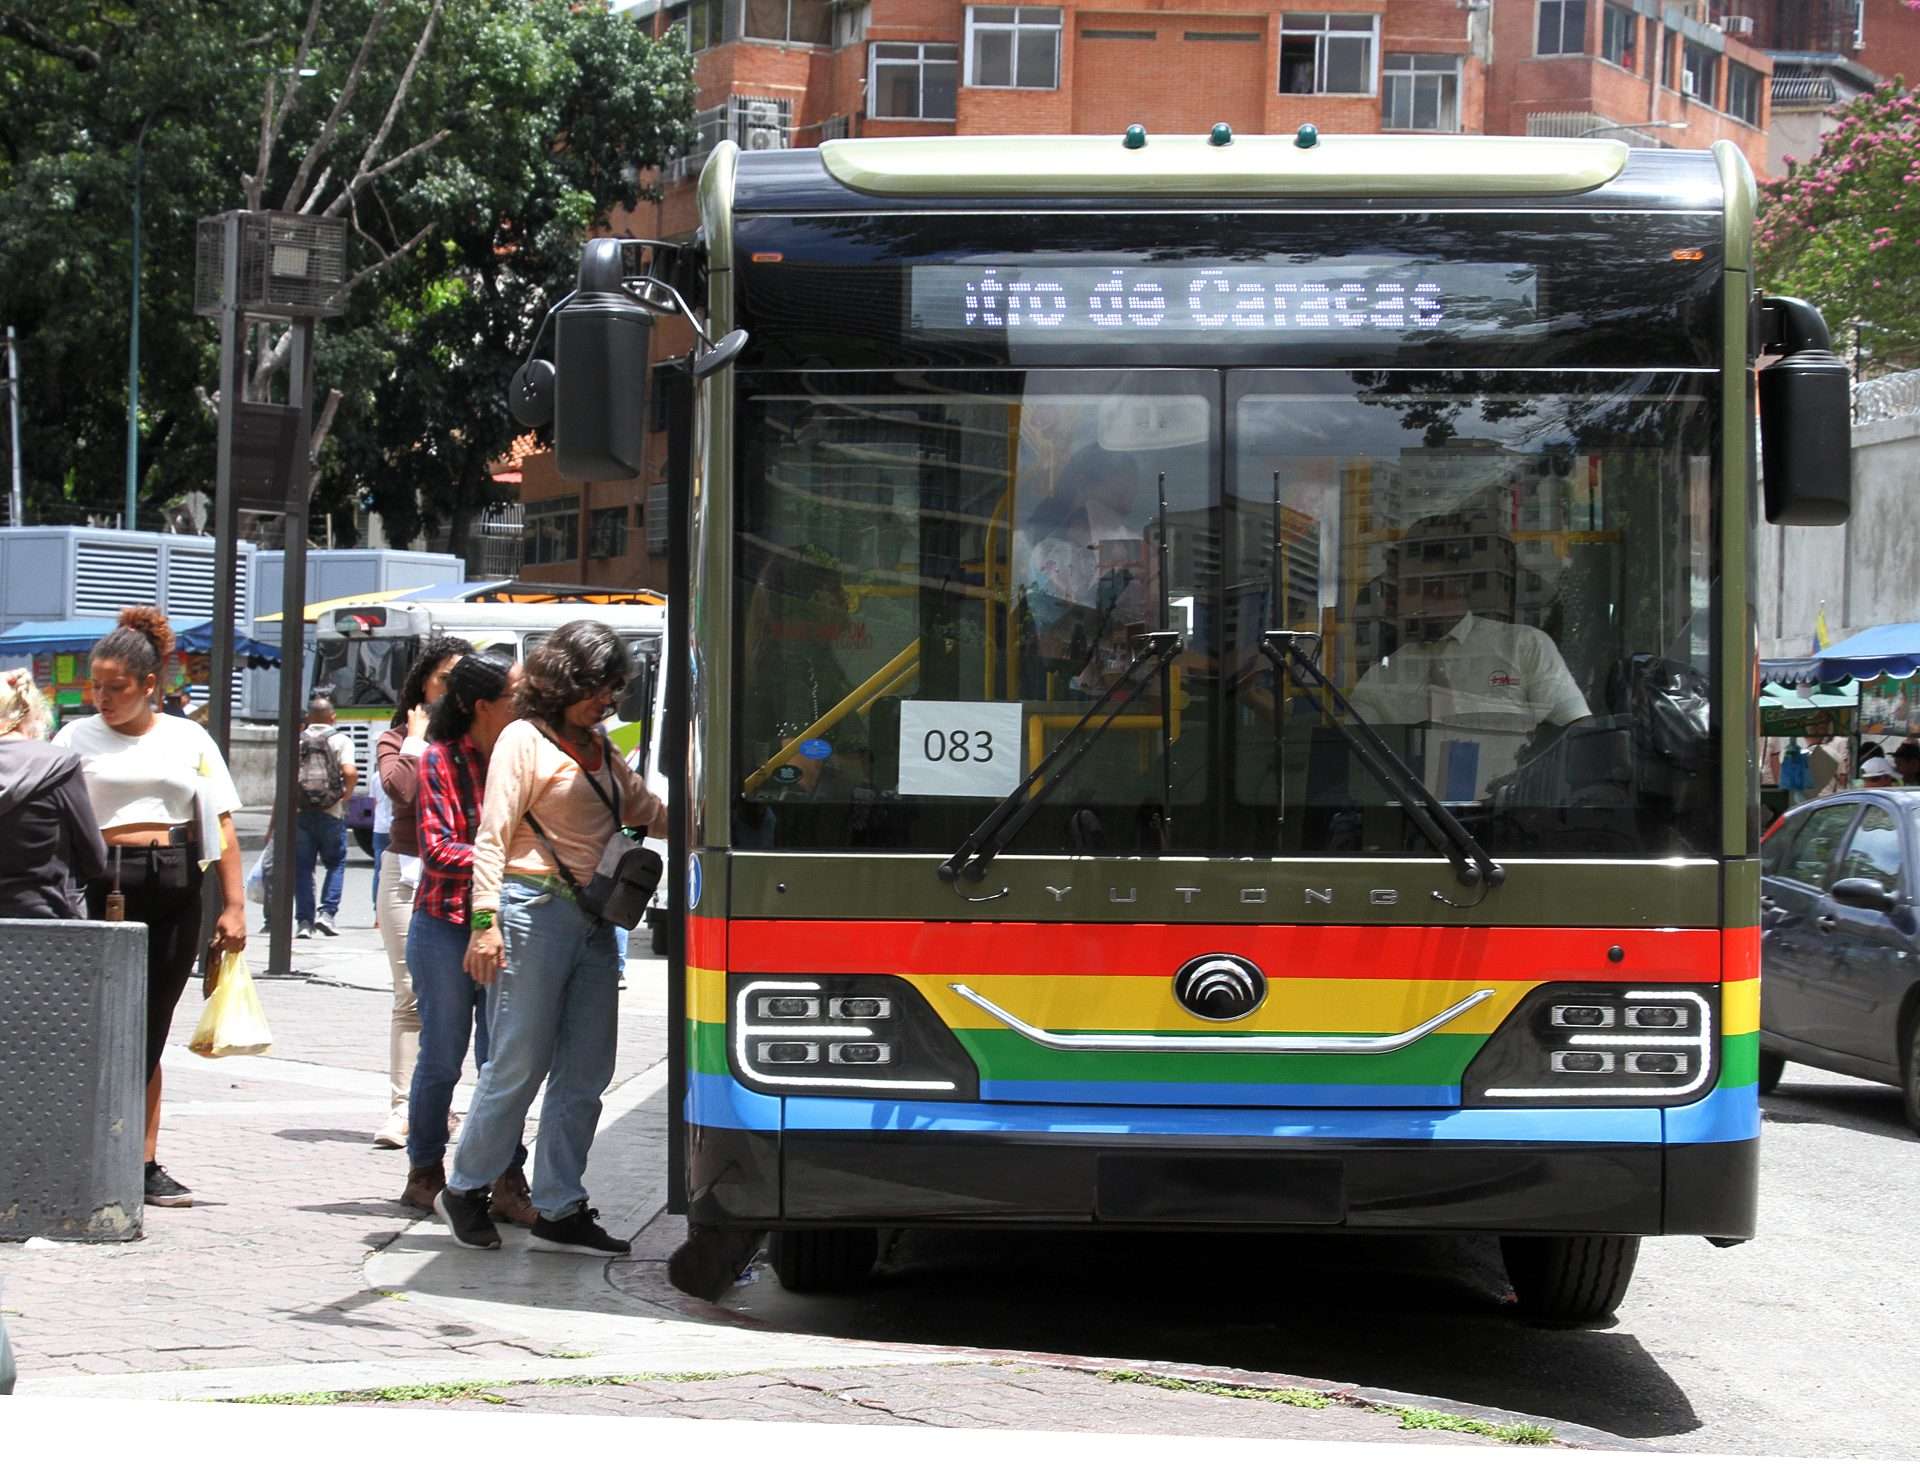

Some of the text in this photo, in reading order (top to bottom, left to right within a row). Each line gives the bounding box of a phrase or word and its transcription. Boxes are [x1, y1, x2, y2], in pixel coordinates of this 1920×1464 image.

[1088, 269, 1166, 326] de
[1188, 269, 1443, 327] Caracas
[924, 729, 994, 763] 083
[1045, 886, 1399, 905] YUTONG
